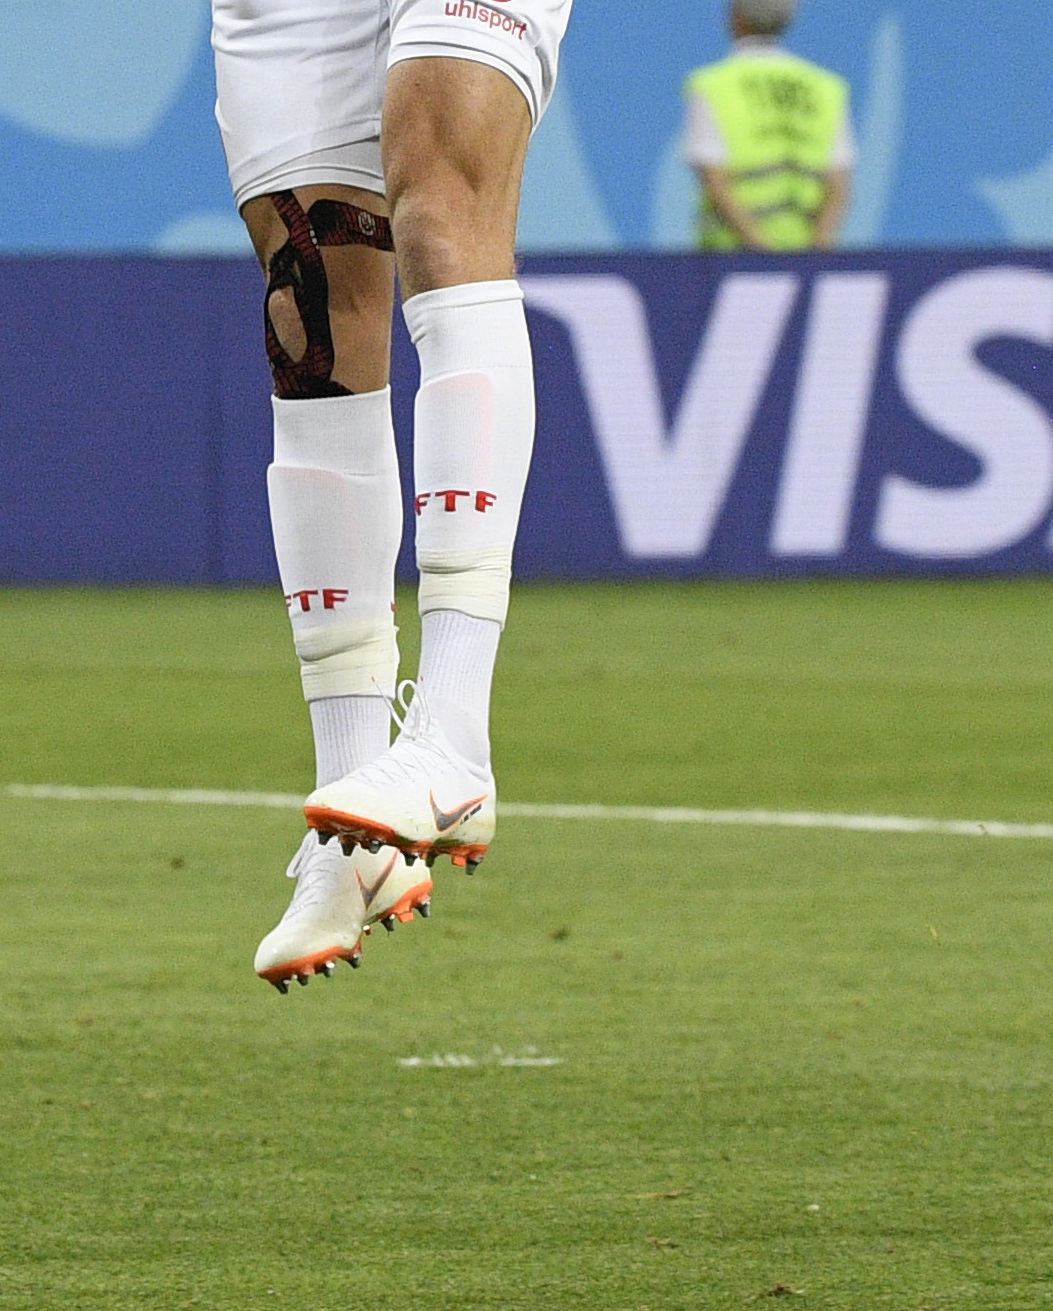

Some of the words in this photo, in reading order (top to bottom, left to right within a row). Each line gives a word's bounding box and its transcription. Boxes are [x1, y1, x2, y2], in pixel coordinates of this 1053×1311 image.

[444, 0, 527, 40] uhlsport
[521, 268, 1053, 557] VIS
[414, 489, 497, 516] FTF
